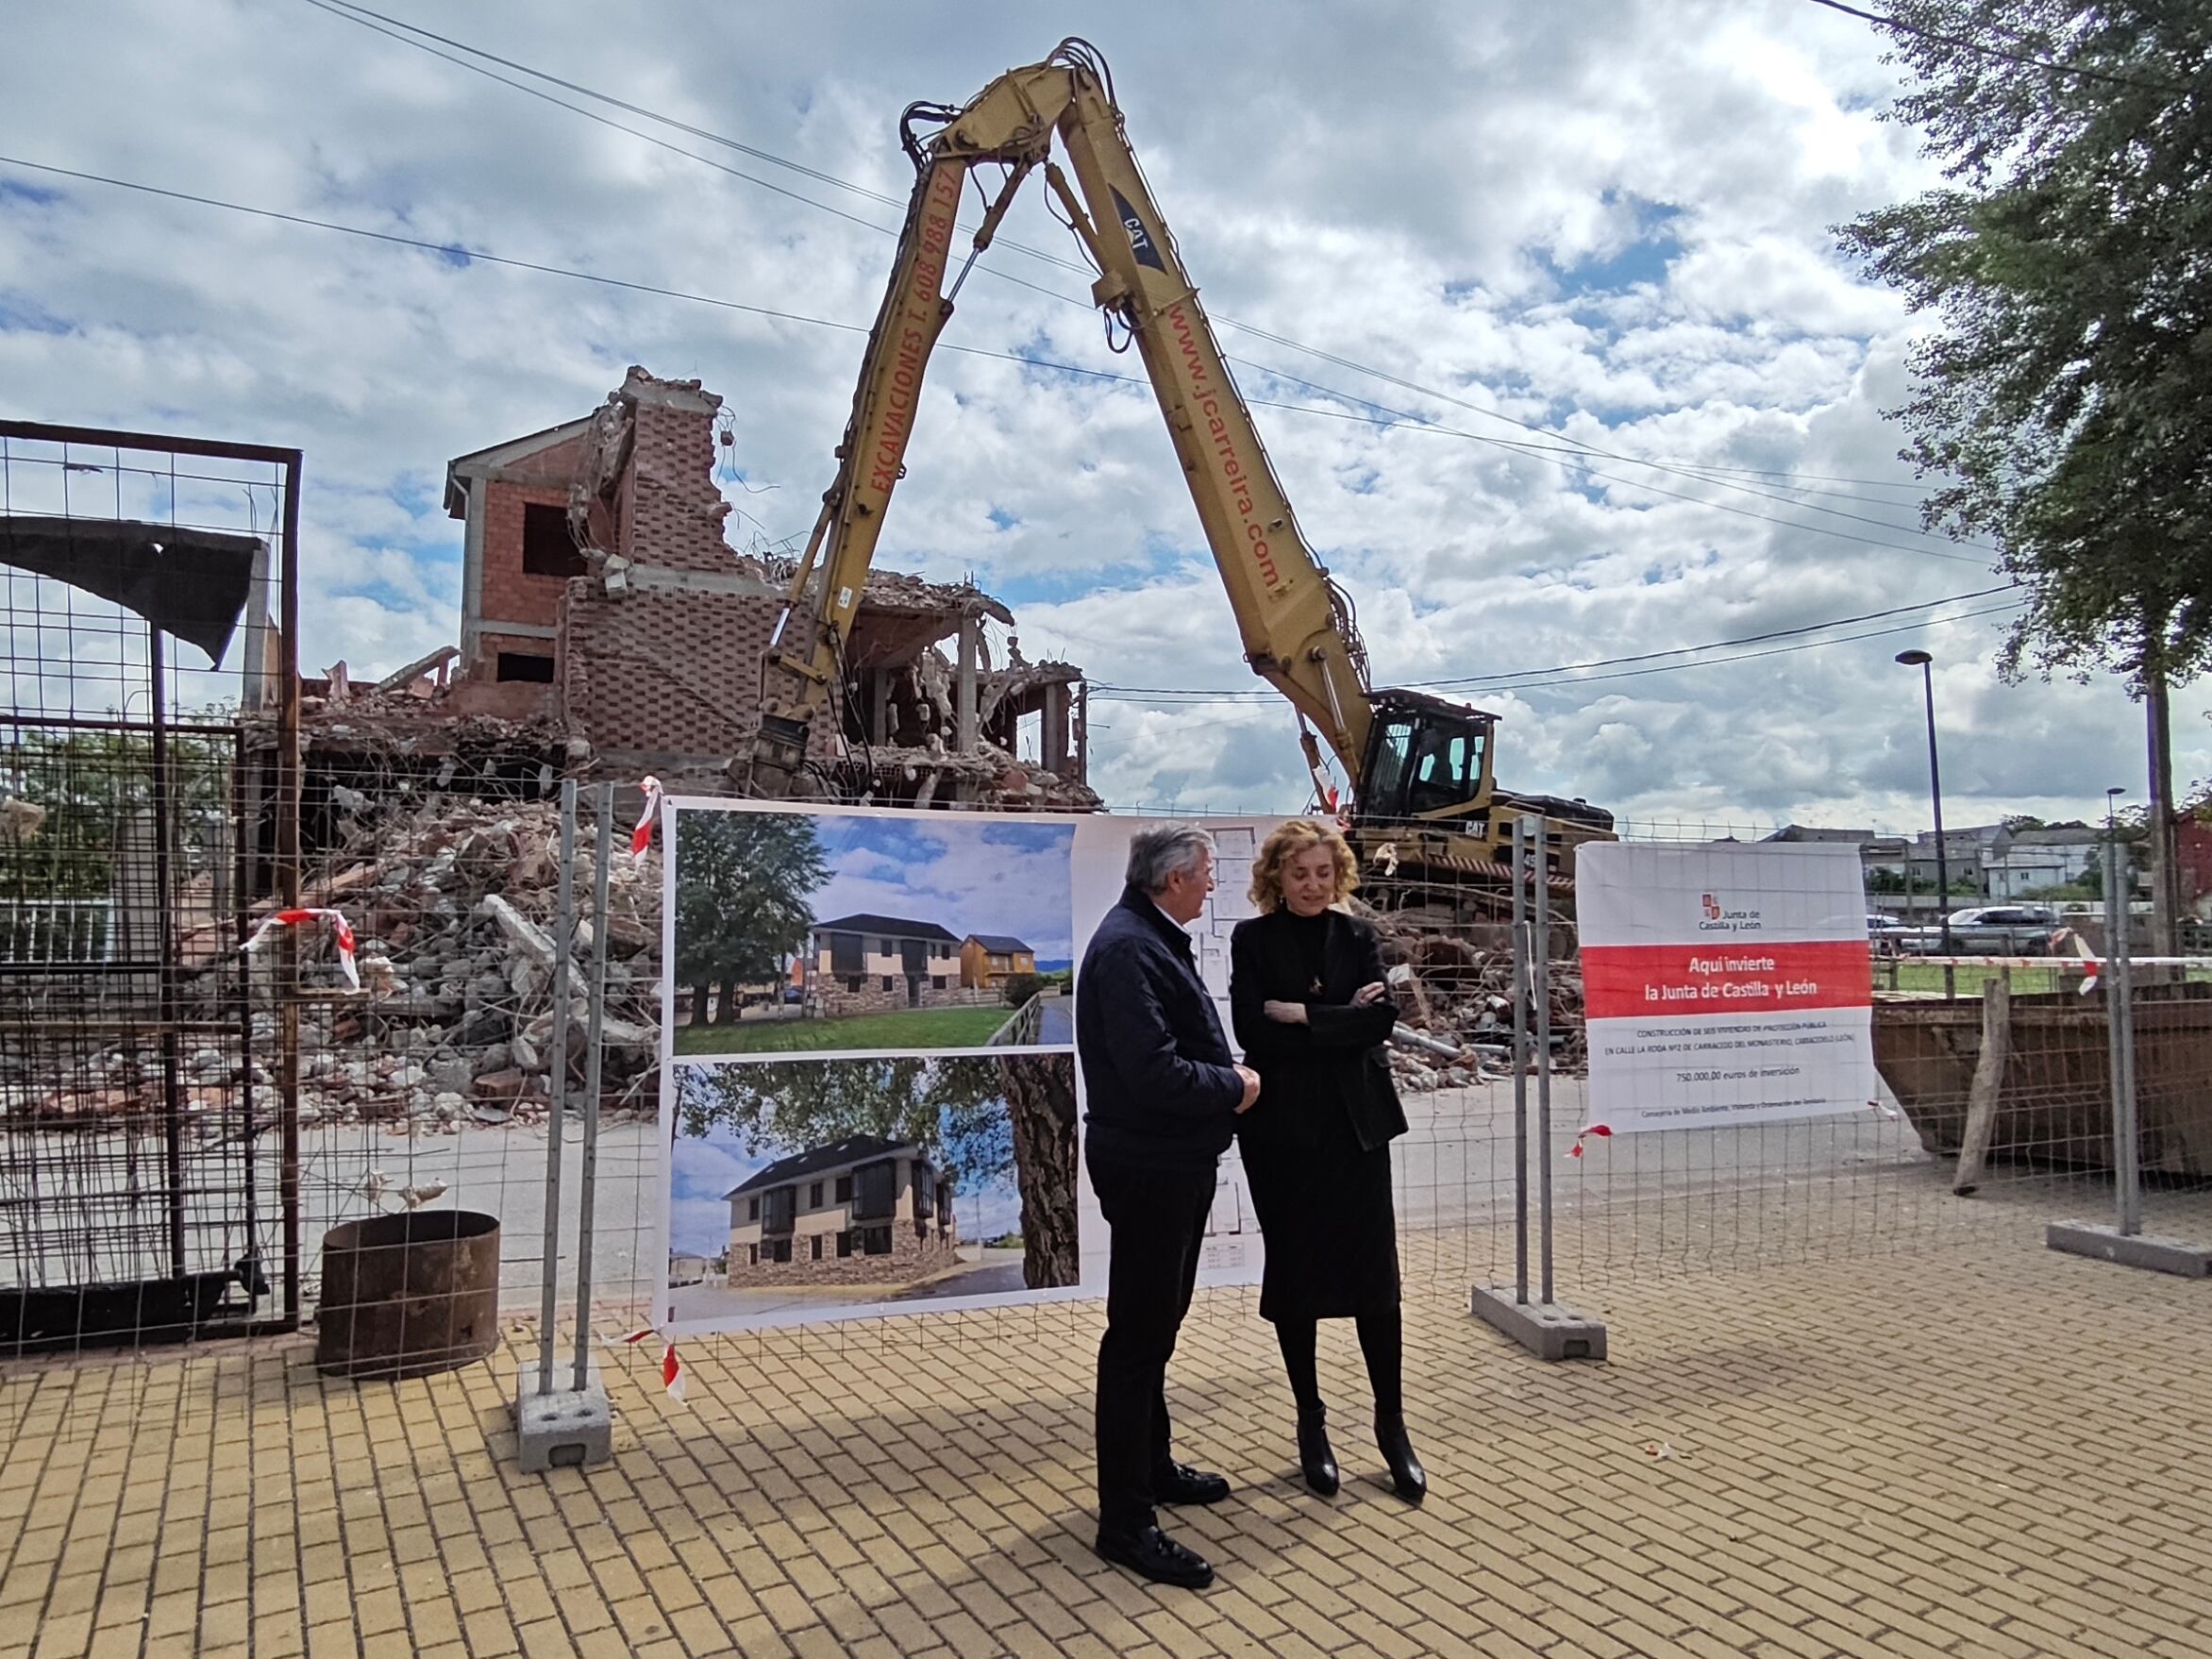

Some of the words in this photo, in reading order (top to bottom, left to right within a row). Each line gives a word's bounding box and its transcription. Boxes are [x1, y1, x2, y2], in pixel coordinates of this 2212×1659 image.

[933, 167, 955, 208] 157
[923, 214, 947, 254] 988
[1124, 218, 1148, 249] CAT
[913, 260, 936, 302] 608
[908, 309, 927, 327] T.
[871, 328, 925, 494] EXCAVACIONES
[1169, 302, 1279, 588] www.jcarreira.com
[1466, 820, 1485, 838] CAT
[1699, 921, 1730, 930] Castilla
[1740, 921, 1761, 930] León
[1722, 911, 1747, 919] Junta
[1689, 956, 1723, 976] Aquí
[1725, 956, 1775, 972] invierte
[1645, 984, 1658, 1000] la
[1662, 984, 1698, 1000] Junta
[1701, 982, 1718, 998] de
[1722, 980, 1769, 997] Castilla
[1775, 983, 1784, 999] y
[1786, 979, 1817, 995] León
[1723, 1071, 1746, 1080] euros
[1749, 1069, 1758, 1078] de
